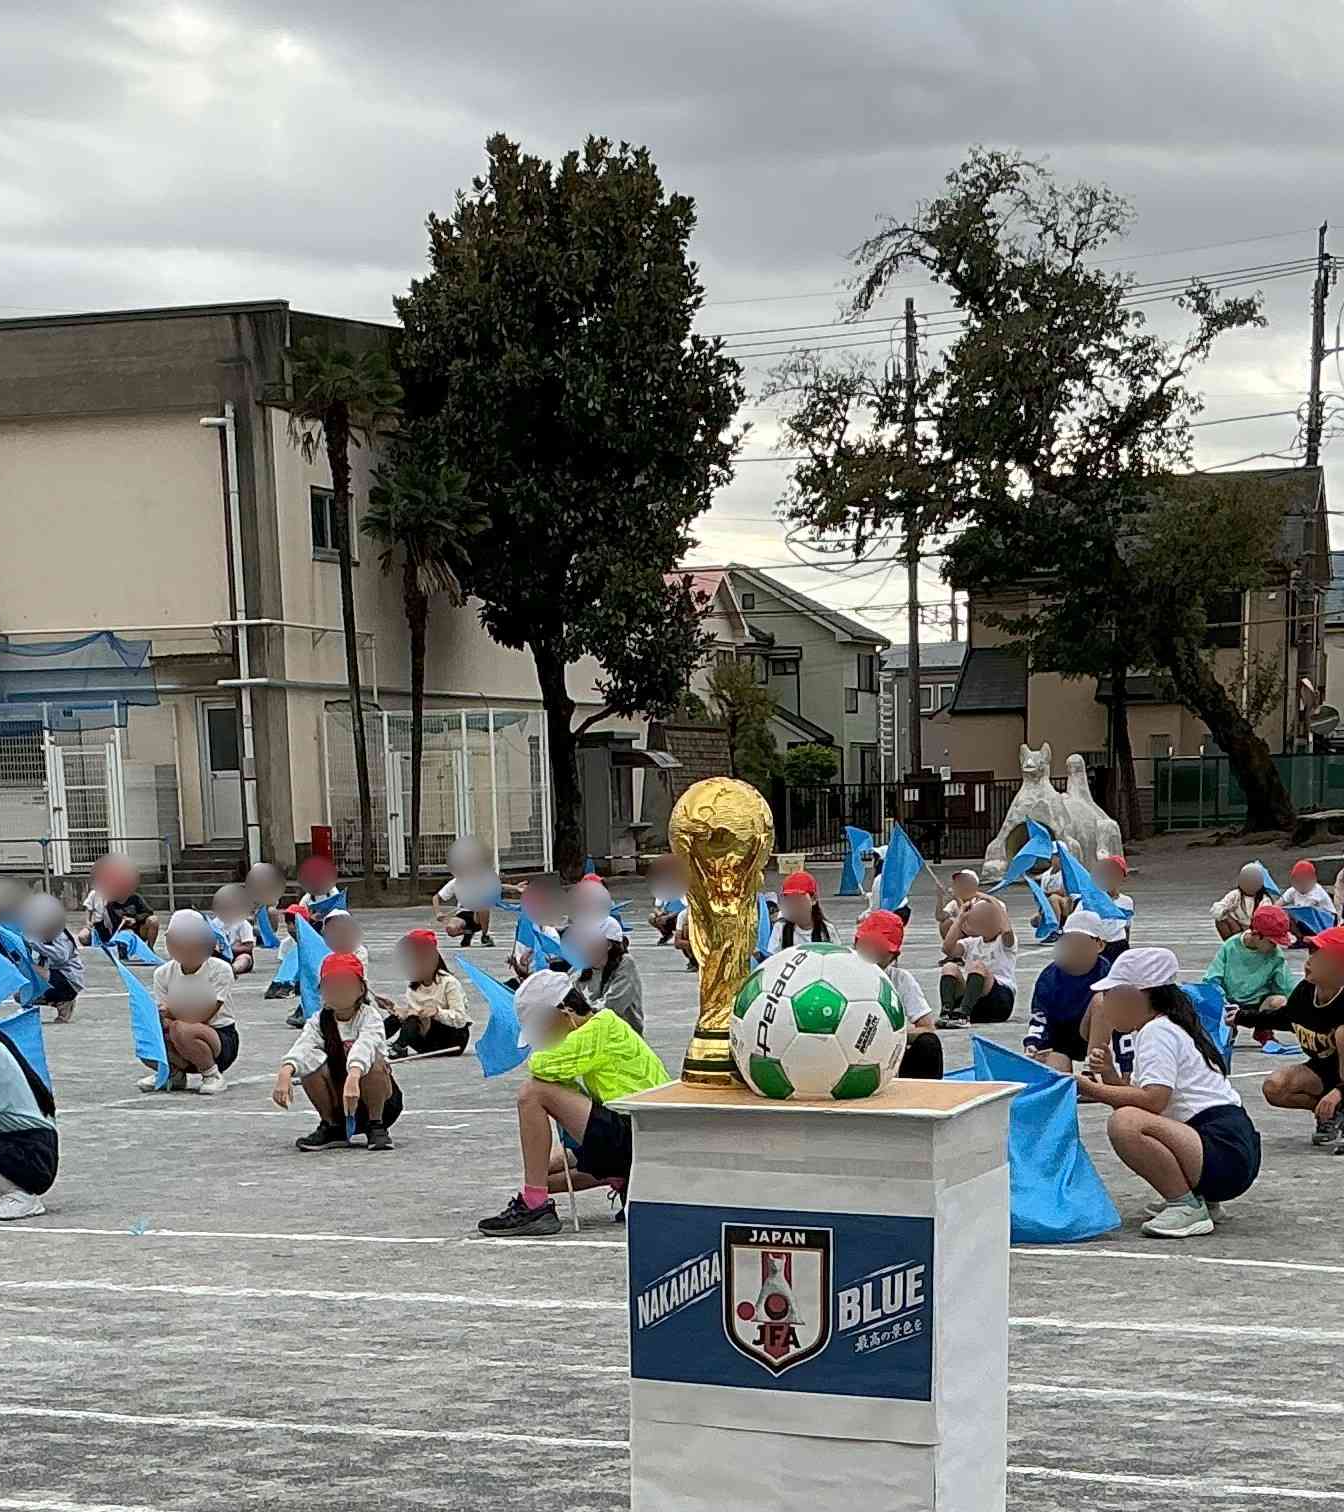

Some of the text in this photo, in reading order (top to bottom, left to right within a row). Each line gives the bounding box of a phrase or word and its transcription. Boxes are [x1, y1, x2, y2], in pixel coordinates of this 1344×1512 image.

[757, 952, 808, 1058] pelada
[749, 1229, 806, 1245] JAPAN
[637, 1251, 722, 1329] NAKAHARA
[838, 1264, 925, 1332] BLUE
[752, 1324, 801, 1349] JFA
